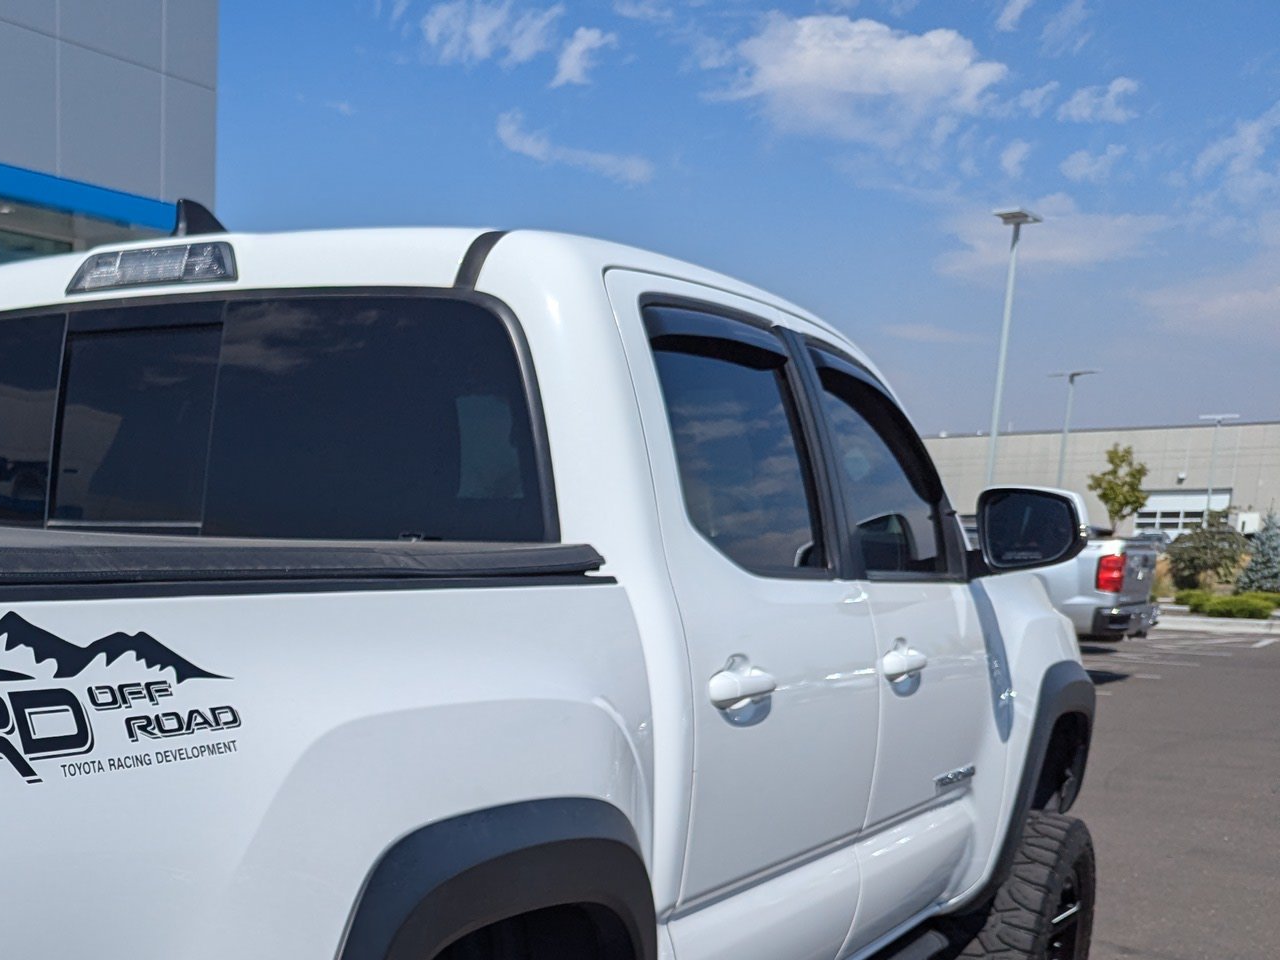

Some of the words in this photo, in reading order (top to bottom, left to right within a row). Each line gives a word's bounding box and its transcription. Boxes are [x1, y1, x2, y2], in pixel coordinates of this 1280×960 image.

[87, 681, 173, 711] OFF
[125, 705, 241, 742] ROAD
[61, 760, 105, 777] TOYOTA
[108, 753, 152, 771] RACING
[156, 740, 238, 764] DEVELOPMENT
